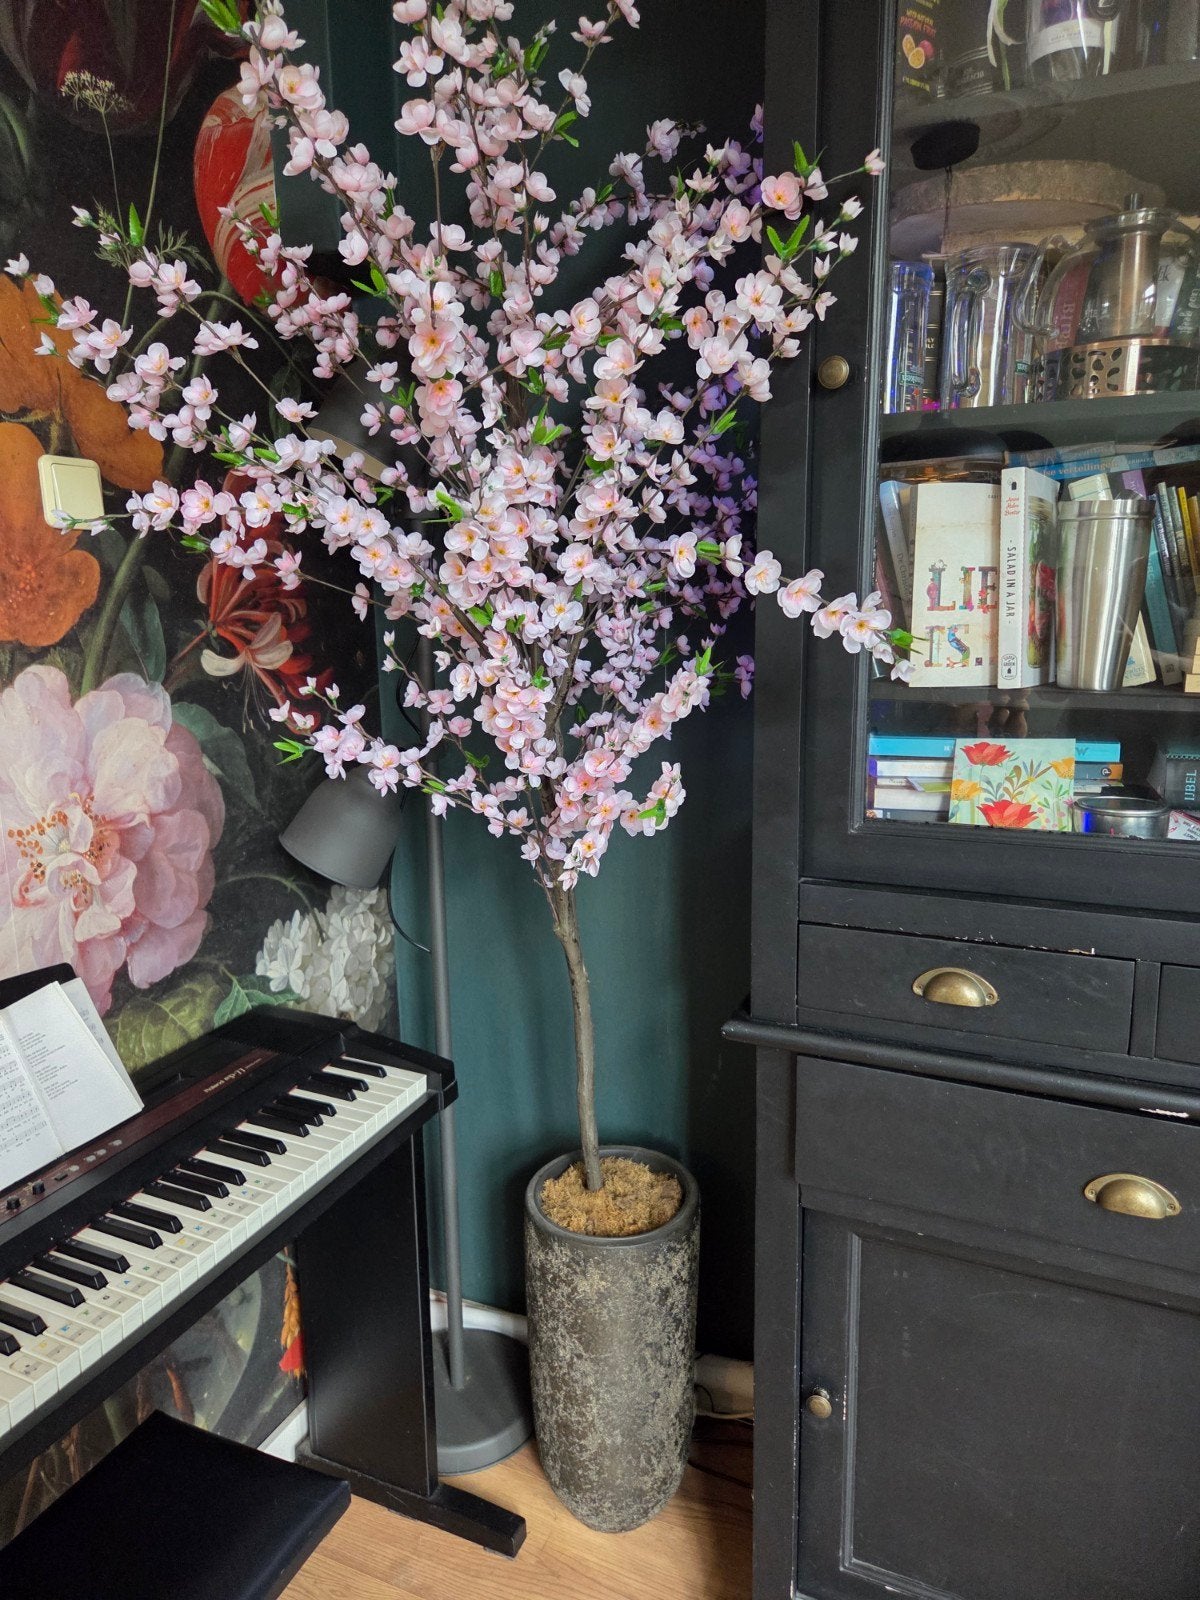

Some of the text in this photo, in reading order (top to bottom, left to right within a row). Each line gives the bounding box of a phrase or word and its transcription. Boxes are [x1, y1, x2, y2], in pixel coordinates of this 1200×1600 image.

[1007, 546, 1017, 577] SALAD
[1007, 579, 1016, 588] IN
[1006, 600, 1015, 618] JAR
[1184, 769, 1197, 801] IJBEL
